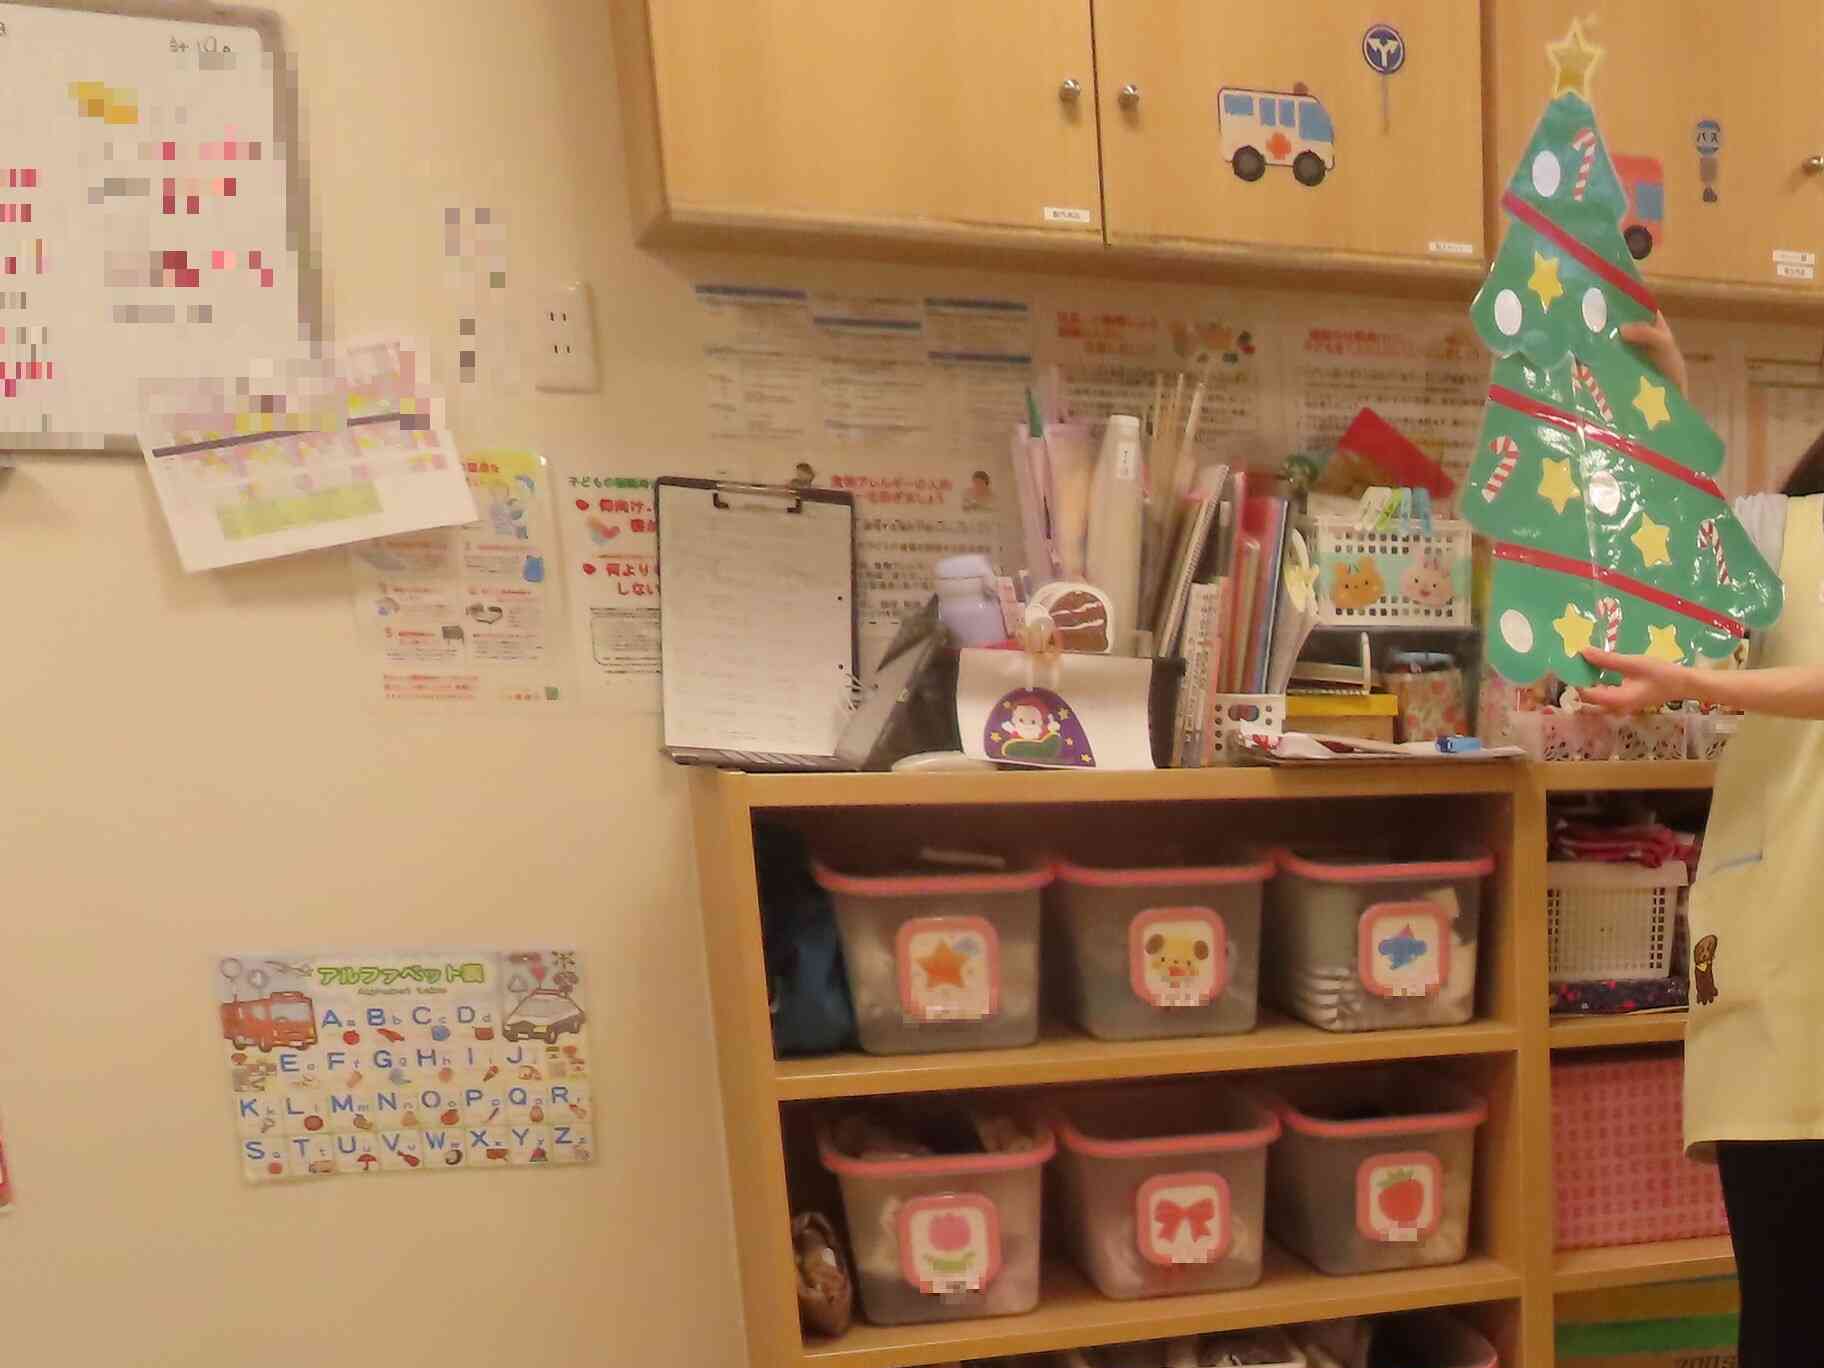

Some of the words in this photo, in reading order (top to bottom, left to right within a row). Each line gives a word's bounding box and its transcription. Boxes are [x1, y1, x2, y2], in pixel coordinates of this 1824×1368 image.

[1696, 130, 1720, 144] バス
[321, 1008, 343, 1028] A
[366, 1007, 385, 1026] B
[412, 1005, 432, 1025] C
[457, 1005, 476, 1024] D
[280, 1053, 300, 1072] E
[326, 1052, 345, 1071] F
[373, 1049, 392, 1068] G
[416, 1049, 437, 1067] H
[468, 1047, 473, 1065] I
[506, 1047, 522, 1064] J
[240, 1098, 259, 1118] K
[286, 1097, 305, 1115] L
[331, 1094, 354, 1113] M
[377, 1091, 398, 1111] N
[421, 1090, 441, 1108] O
[465, 1088, 483, 1107] P
[508, 1087, 527, 1106] Q
[551, 1086, 569, 1104] R
[244, 1141, 265, 1160] S
[292, 1138, 310, 1157] T
[337, 1135, 356, 1154] U
[382, 1133, 400, 1151] V
[425, 1131, 446, 1150] W
[469, 1129, 490, 1148] X
[512, 1127, 530, 1147] Y
[554, 1126, 573, 1145] Z
